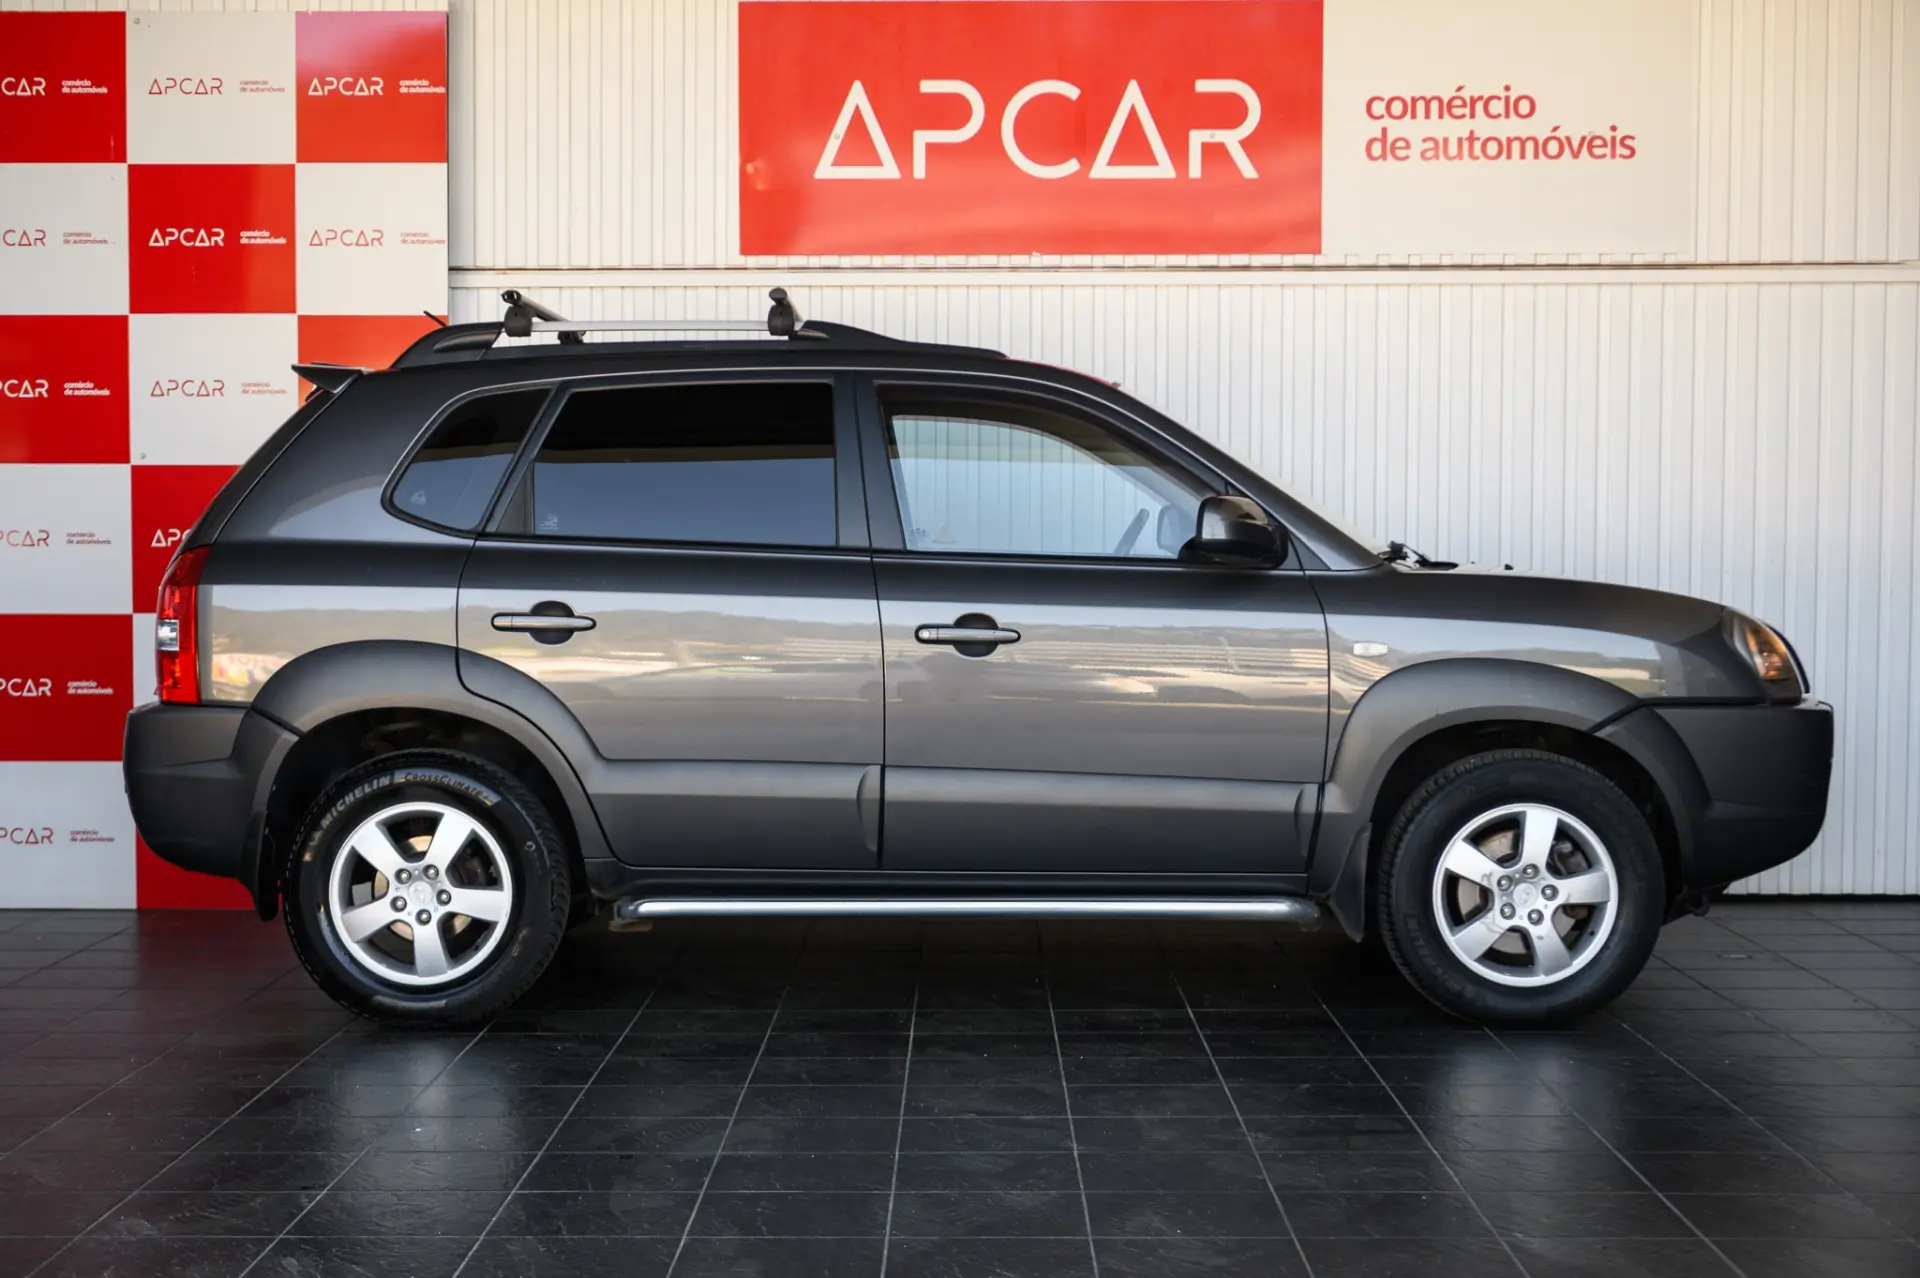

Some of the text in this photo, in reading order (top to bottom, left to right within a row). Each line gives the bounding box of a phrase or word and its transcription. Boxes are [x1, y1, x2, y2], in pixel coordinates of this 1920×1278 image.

[148, 78, 223, 95] APCAR
[308, 77, 384, 96] APCAR
[1365, 85, 1536, 120] comércio
[813, 79, 1262, 180] APCAR
[1365, 125, 1636, 161] de automóveis
[148, 228, 225, 247] APCAR
[309, 229, 384, 246] APCAR
[0, 379, 49, 398] CAR
[150, 380, 225, 397] APCAR
[320, 775, 391, 829] MICHELIN
